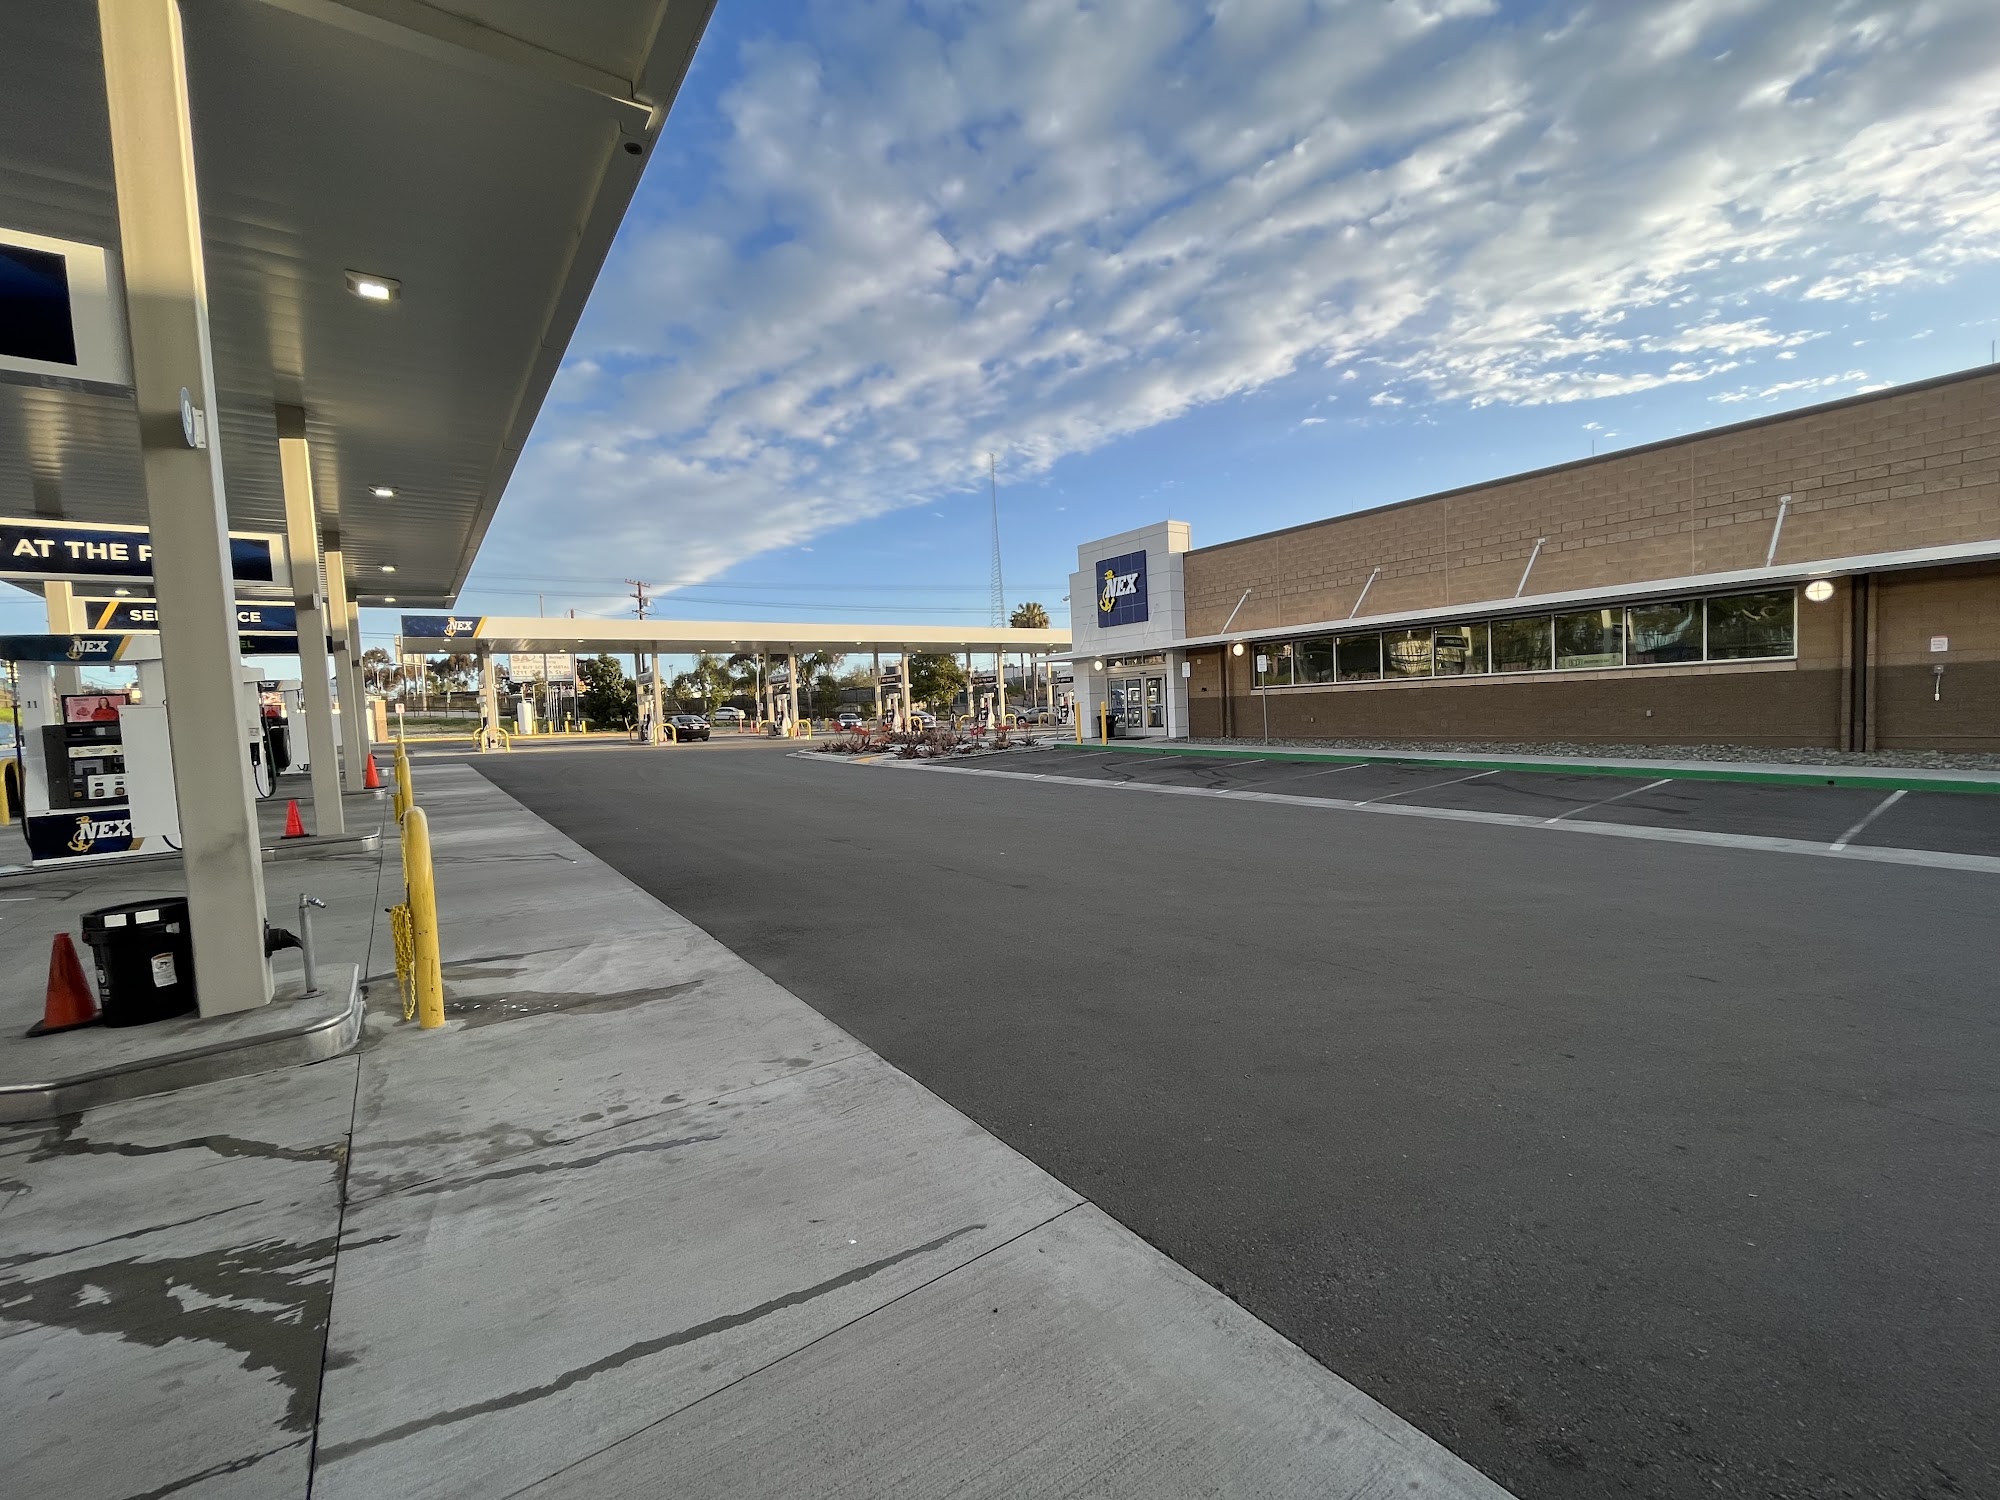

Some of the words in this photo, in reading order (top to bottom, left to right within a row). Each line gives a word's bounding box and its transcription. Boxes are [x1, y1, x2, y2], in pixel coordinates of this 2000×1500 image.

[12, 538, 55, 557] AT
[64, 541, 130, 561] THE
[1105, 572, 1139, 598] NEX
[450, 620, 474, 631] NEX
[73, 640, 110, 653] NEX
[78, 819, 132, 840] NEX
